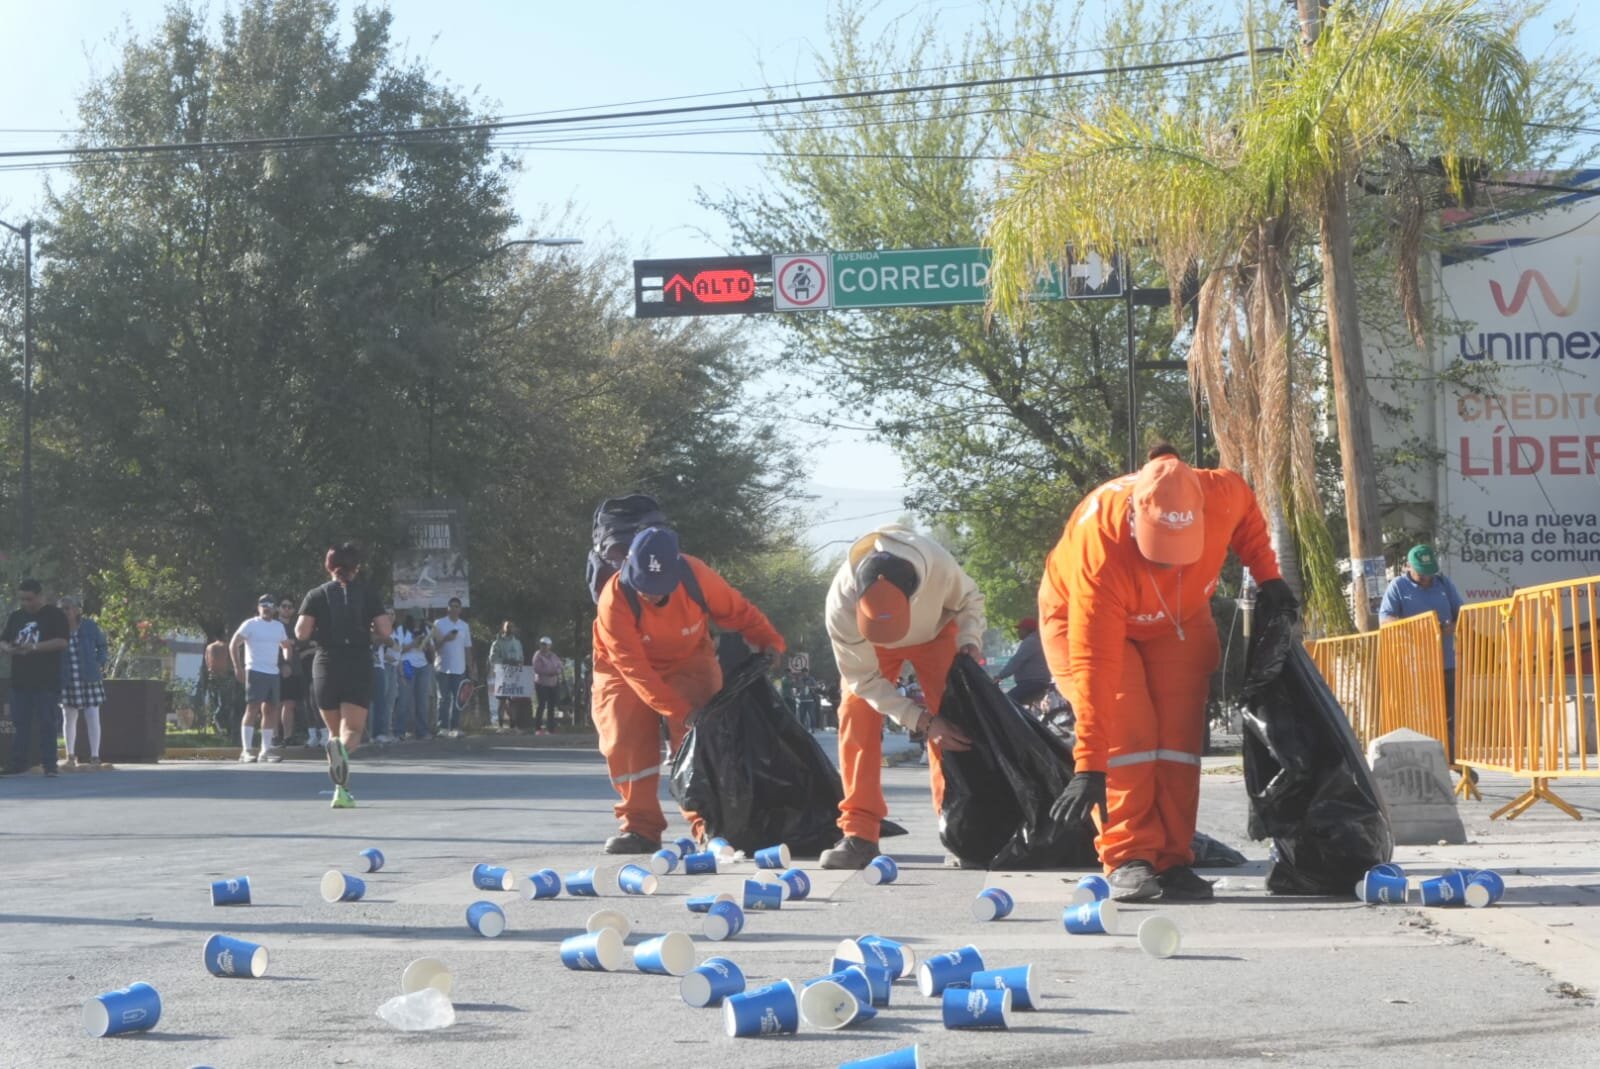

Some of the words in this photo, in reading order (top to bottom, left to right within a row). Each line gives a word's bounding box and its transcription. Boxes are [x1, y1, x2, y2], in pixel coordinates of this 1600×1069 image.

[837, 252, 879, 261] AVENIDA
[696, 277, 750, 295] ALTO
[1487, 511, 1528, 527] Una
[1535, 513, 1597, 527] nueva
[1464, 528, 1525, 545] forma
[1531, 528, 1557, 545] de
[648, 554, 662, 572] LA
[1461, 546, 1524, 563] banca
